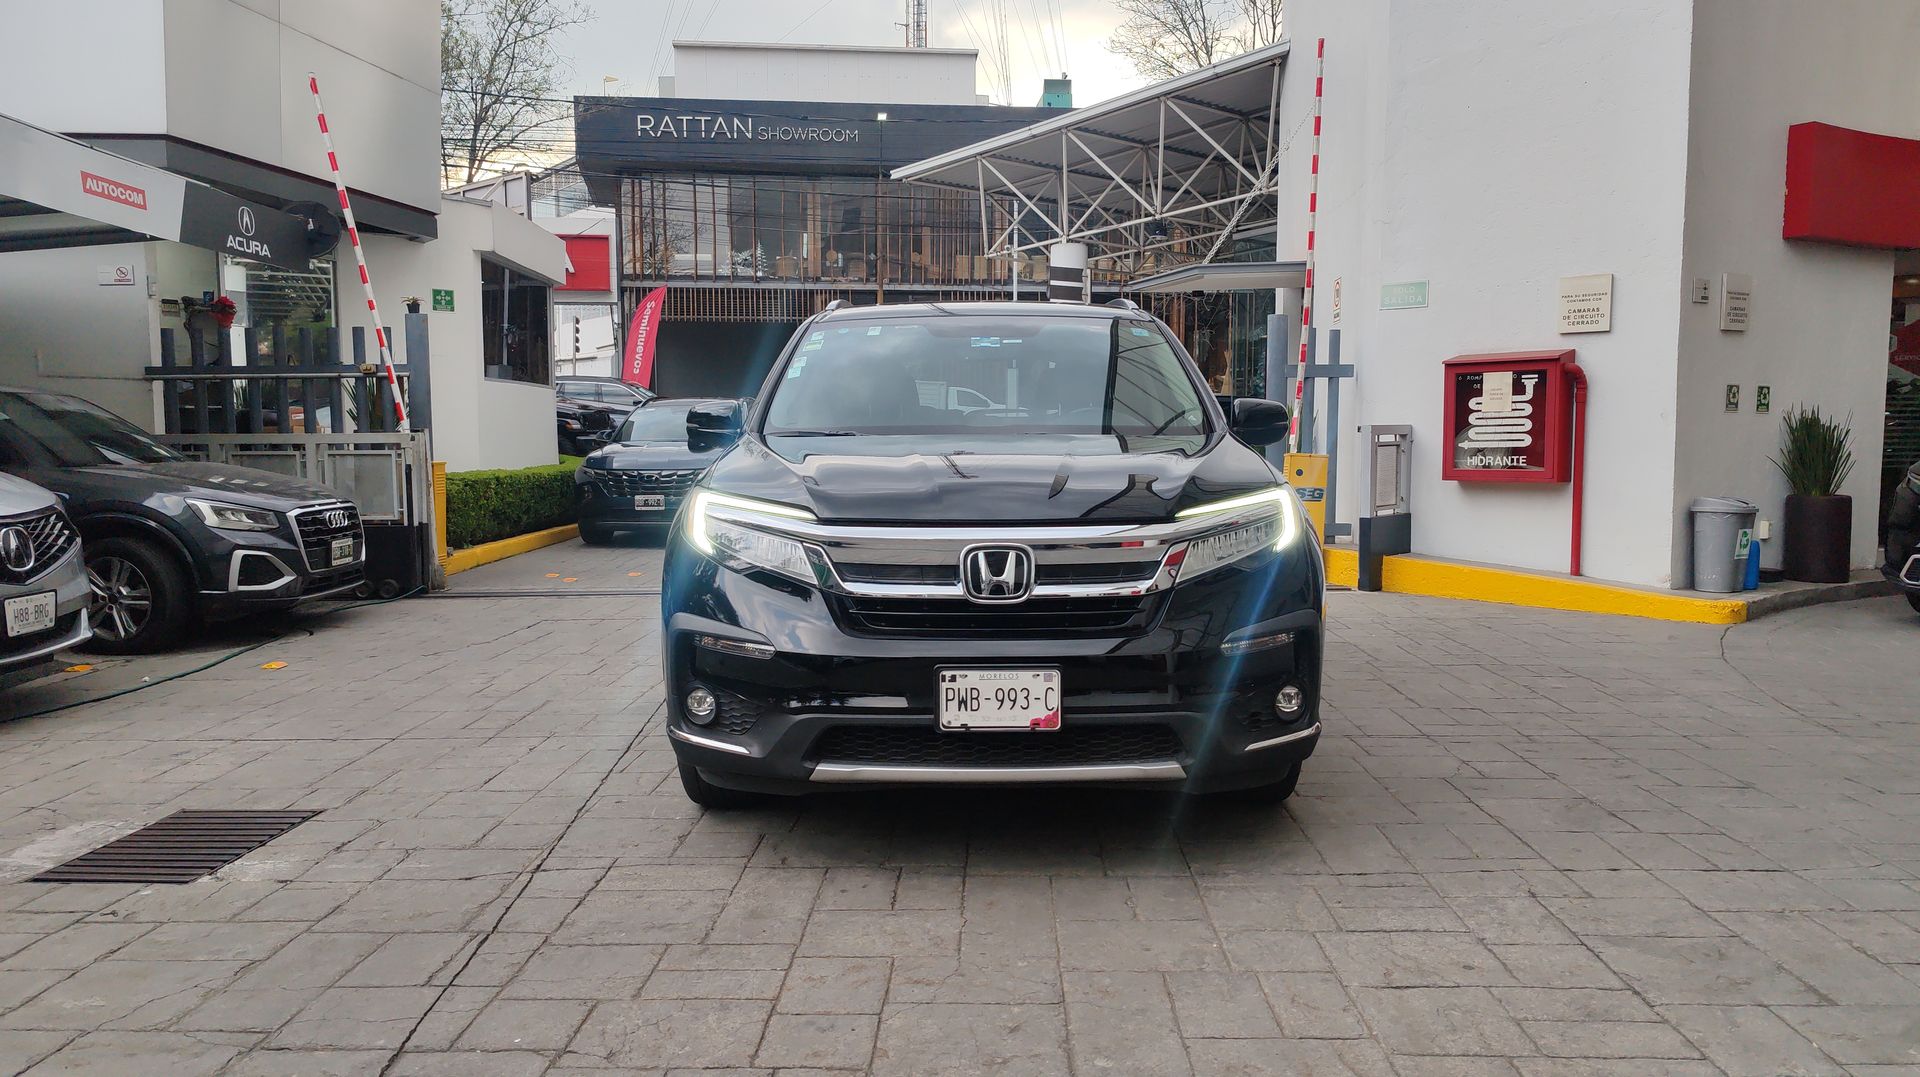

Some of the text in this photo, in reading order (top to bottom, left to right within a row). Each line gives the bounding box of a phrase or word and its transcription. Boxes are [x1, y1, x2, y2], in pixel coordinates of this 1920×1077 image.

[637, 115, 859, 142] RATTAN SHOWROOM
[85, 177, 144, 206] AUTOCOM
[226, 234, 271, 258] ACURA
[1384, 295, 1423, 305] SALIDA
[633, 300, 656, 374] Seminuevos
[1466, 455, 1528, 466] HIDRANTE
[13, 603, 50, 624] H88-BRG
[945, 687, 1055, 712] PWB-993-C
